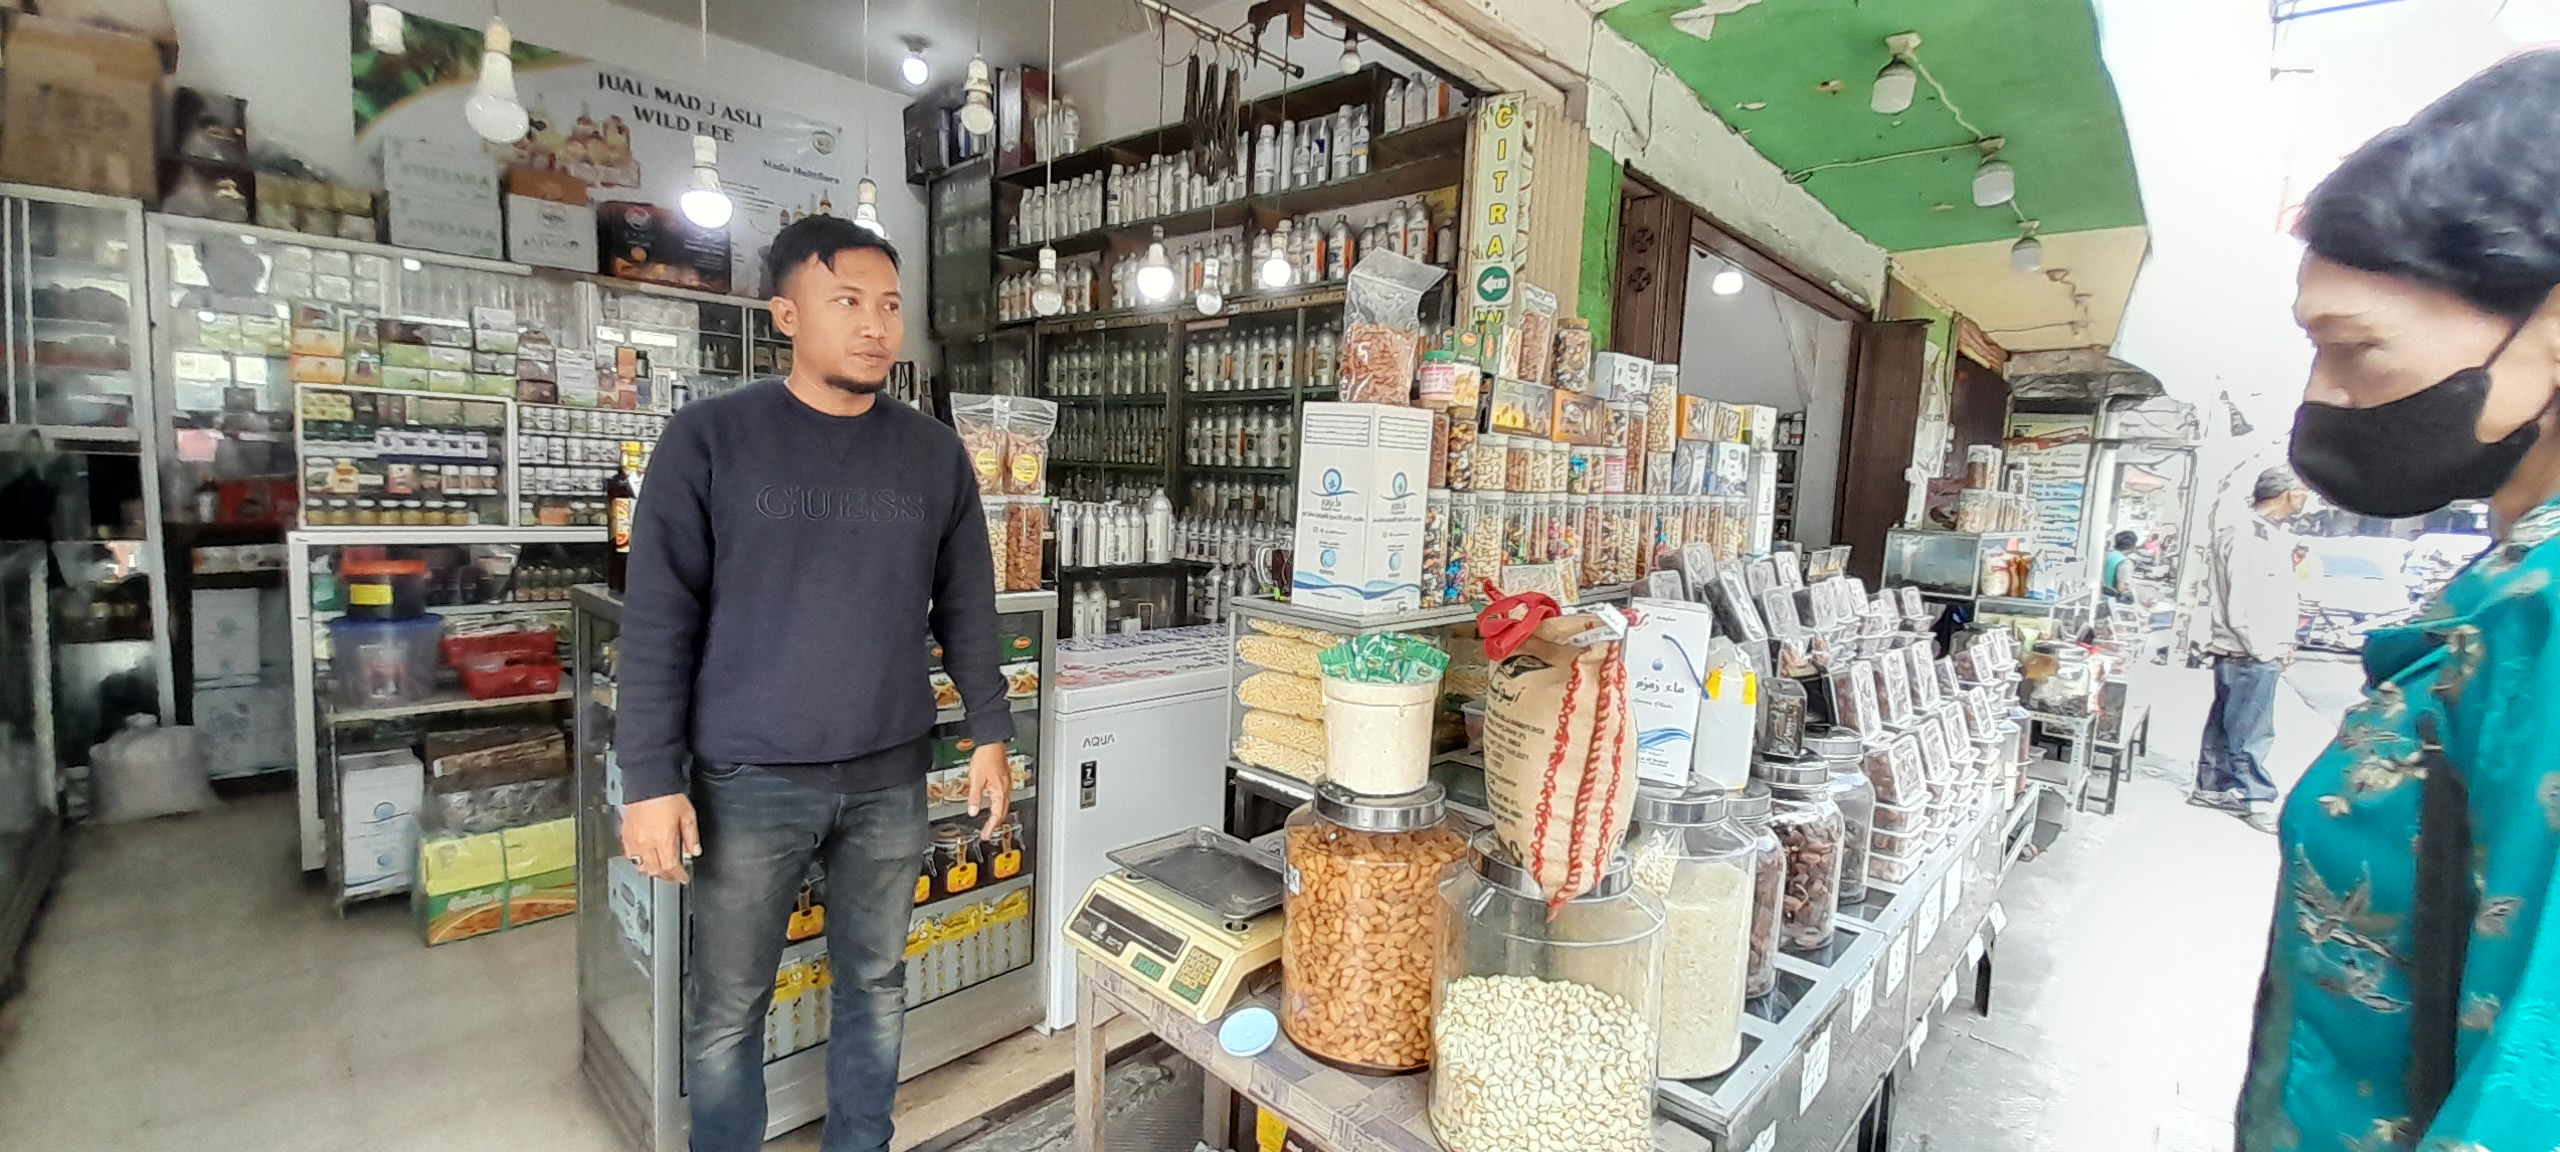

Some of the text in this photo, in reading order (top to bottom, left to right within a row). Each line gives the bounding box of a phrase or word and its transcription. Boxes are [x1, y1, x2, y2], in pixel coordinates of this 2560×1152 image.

[598, 72, 648, 98] JUAL
[721, 106, 763, 128] ASLI
[634, 105, 690, 131] WILD
[1487, 106, 1513, 259] CITRA
[755, 484, 925, 522] GUESS
[1082, 734, 1115, 748] AQUA
